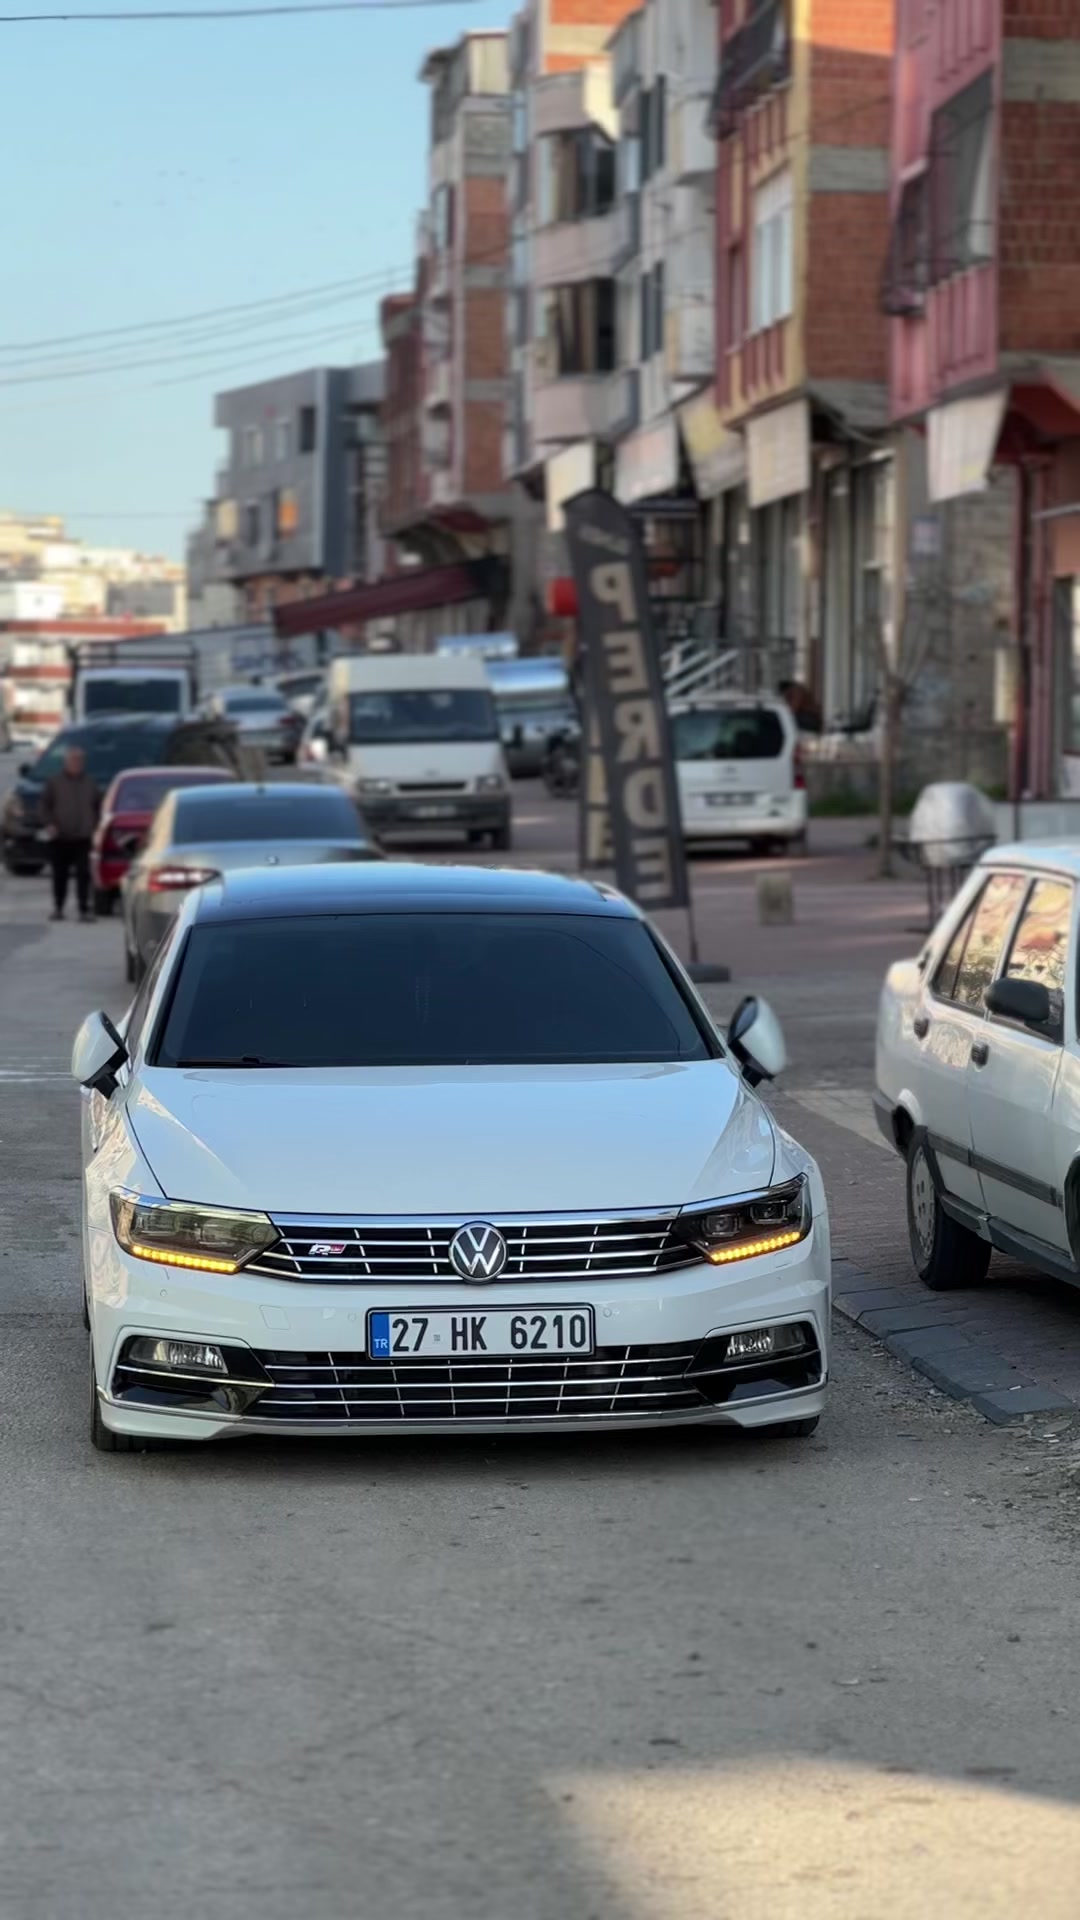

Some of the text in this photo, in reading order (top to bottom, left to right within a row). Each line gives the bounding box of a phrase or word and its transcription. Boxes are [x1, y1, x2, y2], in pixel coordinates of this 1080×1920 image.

[374, 1338, 388, 1349] TR
[392, 1314, 586, 1352] 27 HK 6210
